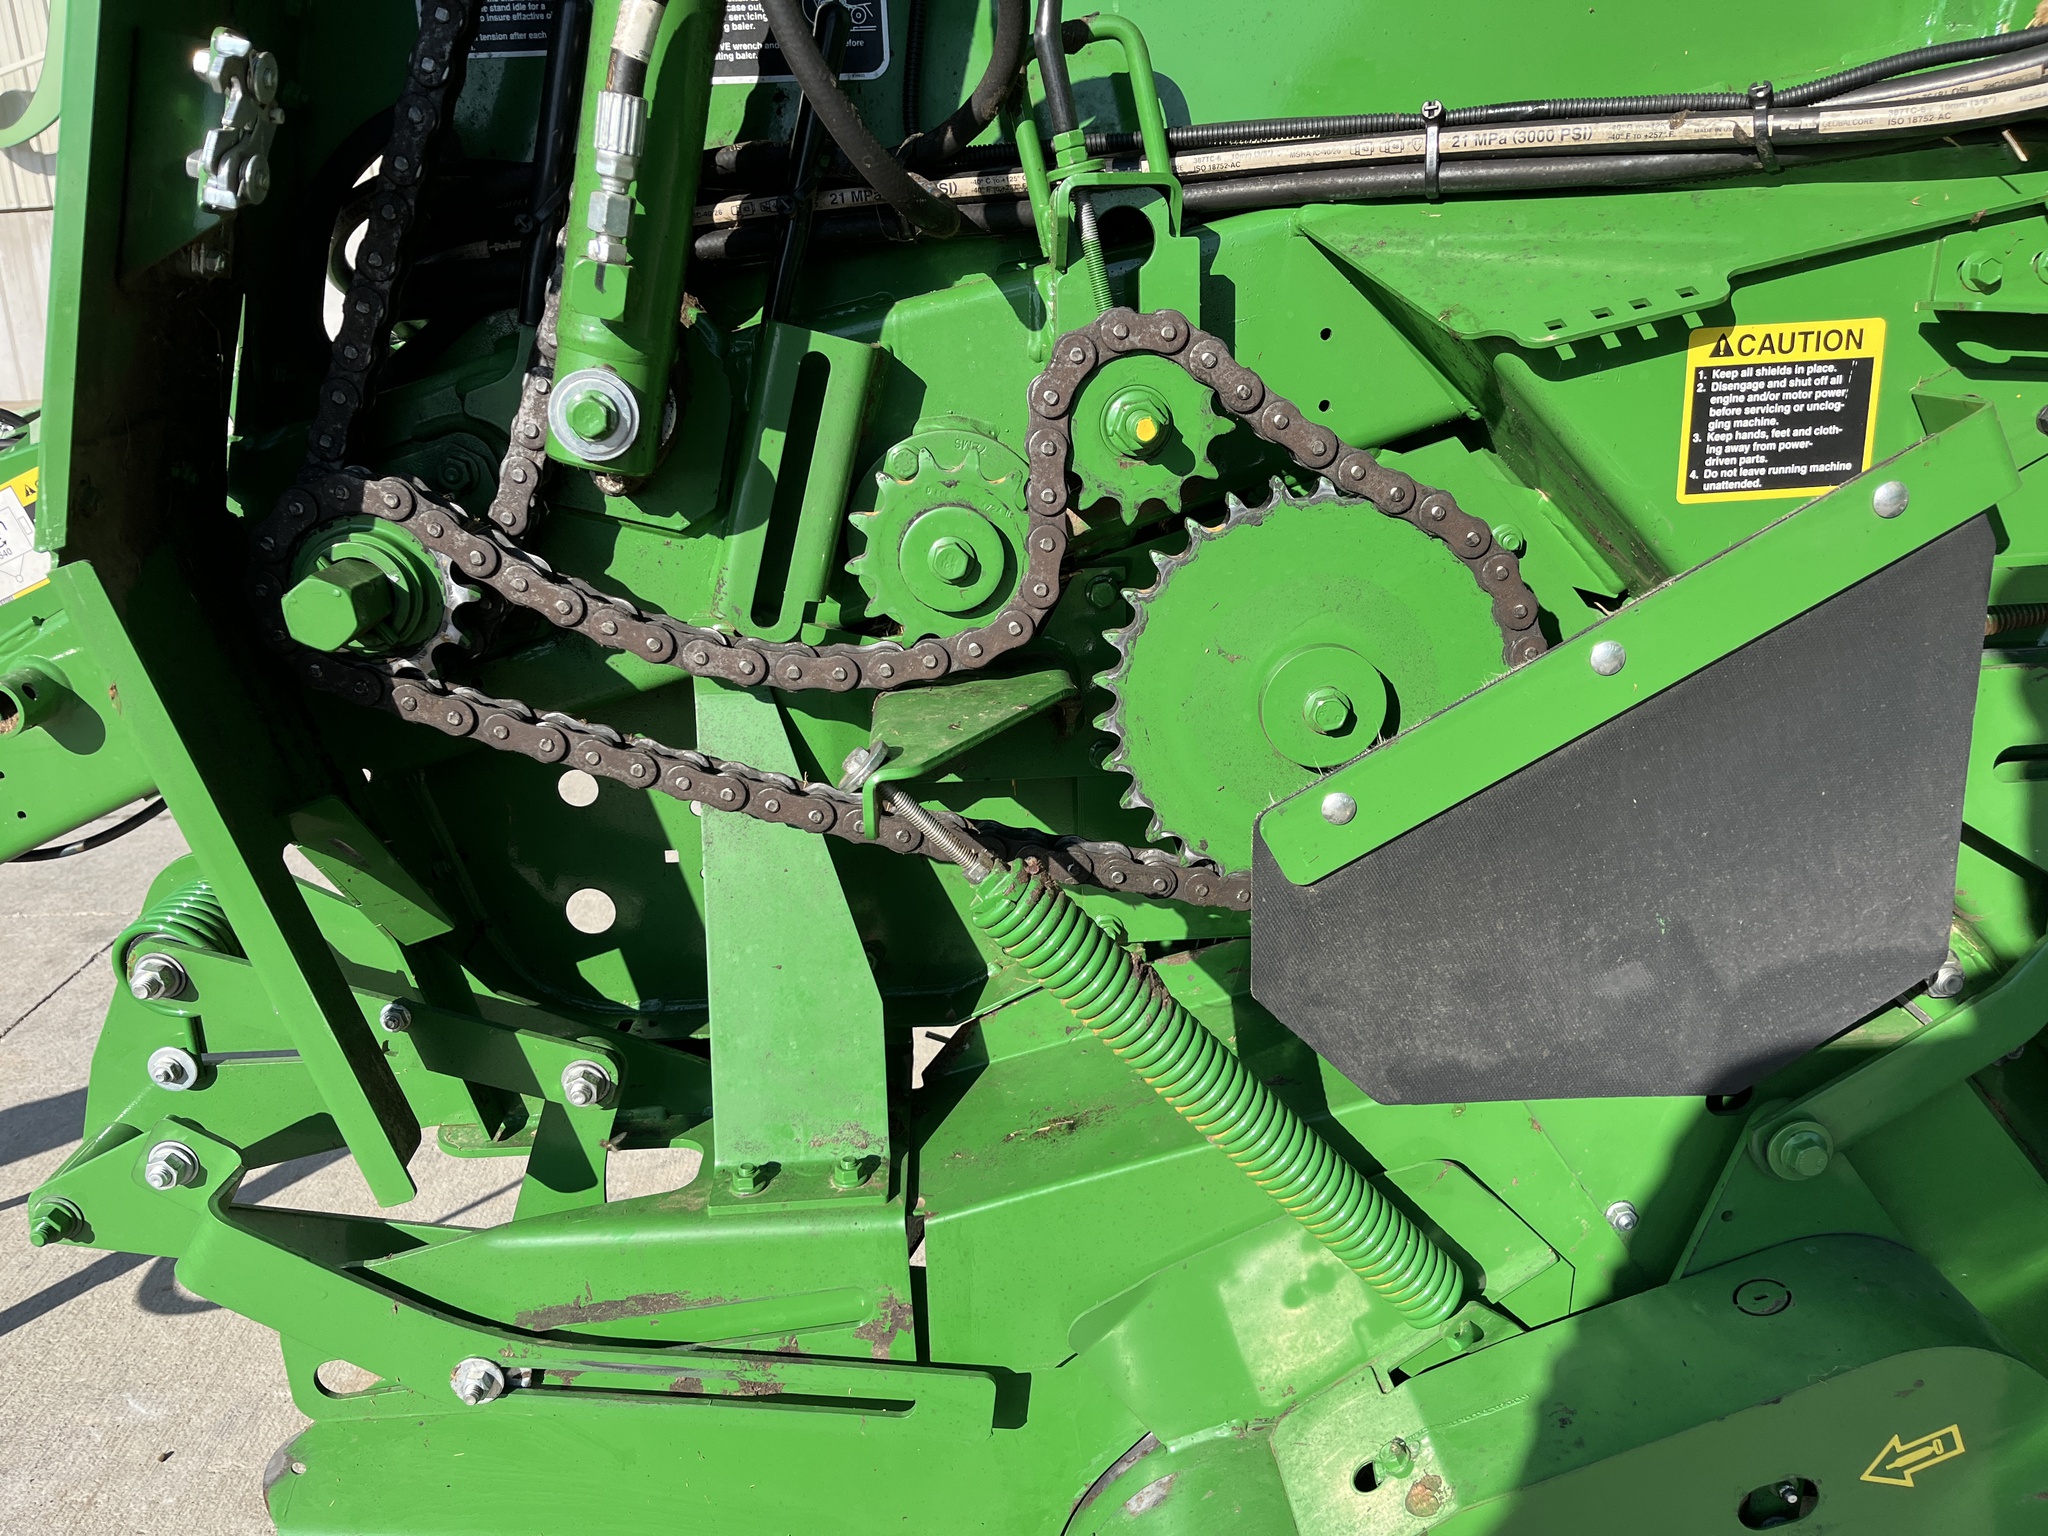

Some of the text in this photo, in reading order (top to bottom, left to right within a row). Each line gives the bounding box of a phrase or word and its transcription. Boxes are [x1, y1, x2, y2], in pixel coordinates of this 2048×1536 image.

[490, 3, 511, 12] stand
[512, 3, 526, 11] idle
[528, 2, 539, 10] for
[486, 13, 511, 22] insure
[512, 12, 544, 20] effective
[732, 22, 756, 31] baler.
[480, 32, 508, 40] tension
[510, 32, 526, 40] after
[528, 31, 548, 39] each
[732, 42, 762, 50] wrench
[736, 51, 758, 60] baler.
[1888, 112, 1952, 126] ISO 18752-AC
[1452, 126, 1592, 148] 21 MPa (3000 PSI)
[1194, 161, 1240, 172] ISO 18752-AC
[938, 181, 958, 195] SI)
[830, 192, 845, 205] 21
[1737, 328, 1864, 356] CAUTION
[1698, 364, 1838, 380] 1. Keep all shields in place.
[1696, 374, 1842, 393] 2. Disengage and shut off all
[1710, 394, 1745, 406] engine
[1746, 391, 1780, 402] and/or
[1782, 390, 1813, 400] motor
[1708, 400, 1845, 418] before servicing or unclog-
[1708, 416, 1779, 432] ging machine.
[1692, 424, 1843, 443] 3. Keep hands, feet and cloth-
[1706, 440, 1814, 456] ing away from power-
[1704, 454, 1768, 467] driven parts.
[1689, 461, 1852, 480] 4. Do not leave running machine
[1702, 478, 1762, 491] unattended.
